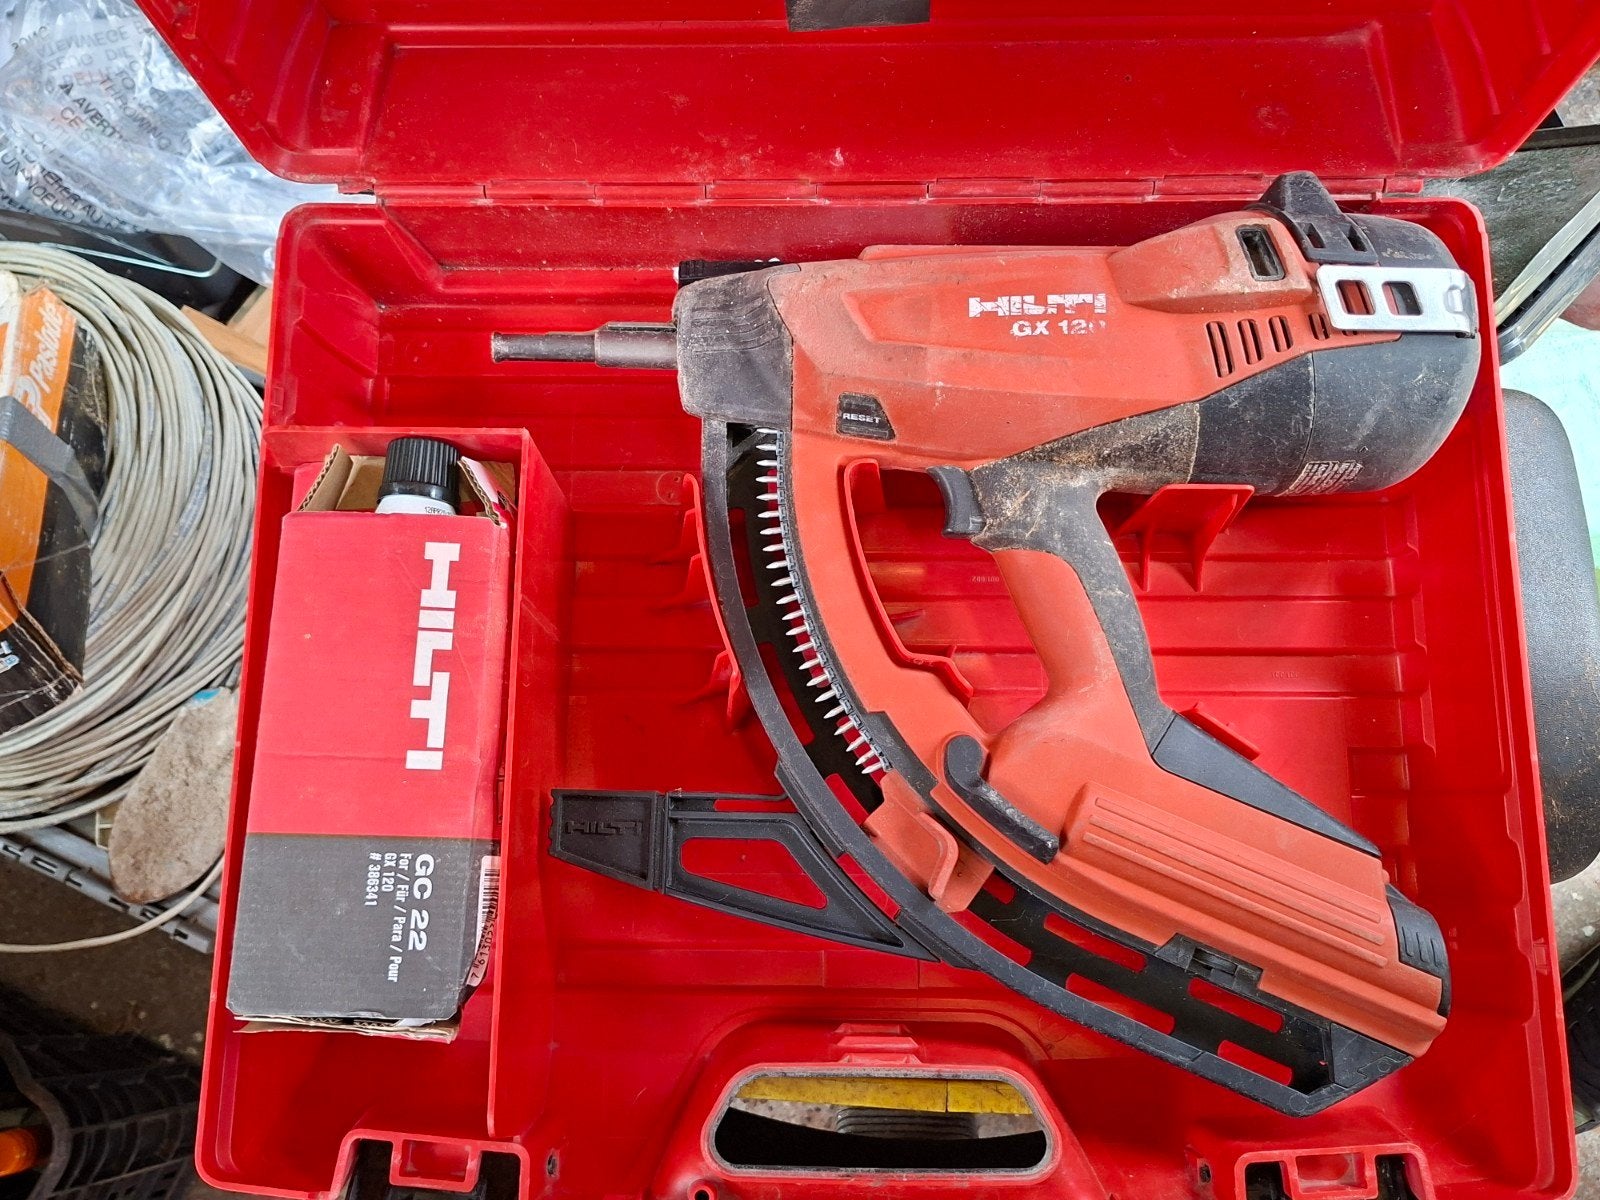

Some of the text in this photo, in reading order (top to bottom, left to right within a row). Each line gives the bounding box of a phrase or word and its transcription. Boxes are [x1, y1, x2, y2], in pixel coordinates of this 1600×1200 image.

[968, 293, 1107, 318] HILTI
[1010, 320, 1050, 337] GX
[842, 412, 881, 424] RESET
[405, 542, 461, 770] HILTI
[564, 819, 643, 836] HILTI
[381, 852, 398, 893] GX 120
[398, 852, 413, 871] For
[364, 863, 381, 906] 386341
[395, 884, 410, 903] Für
[408, 853, 435, 951] GC 22
[391, 916, 407, 942] Para
[387, 956, 403, 983] Pour
